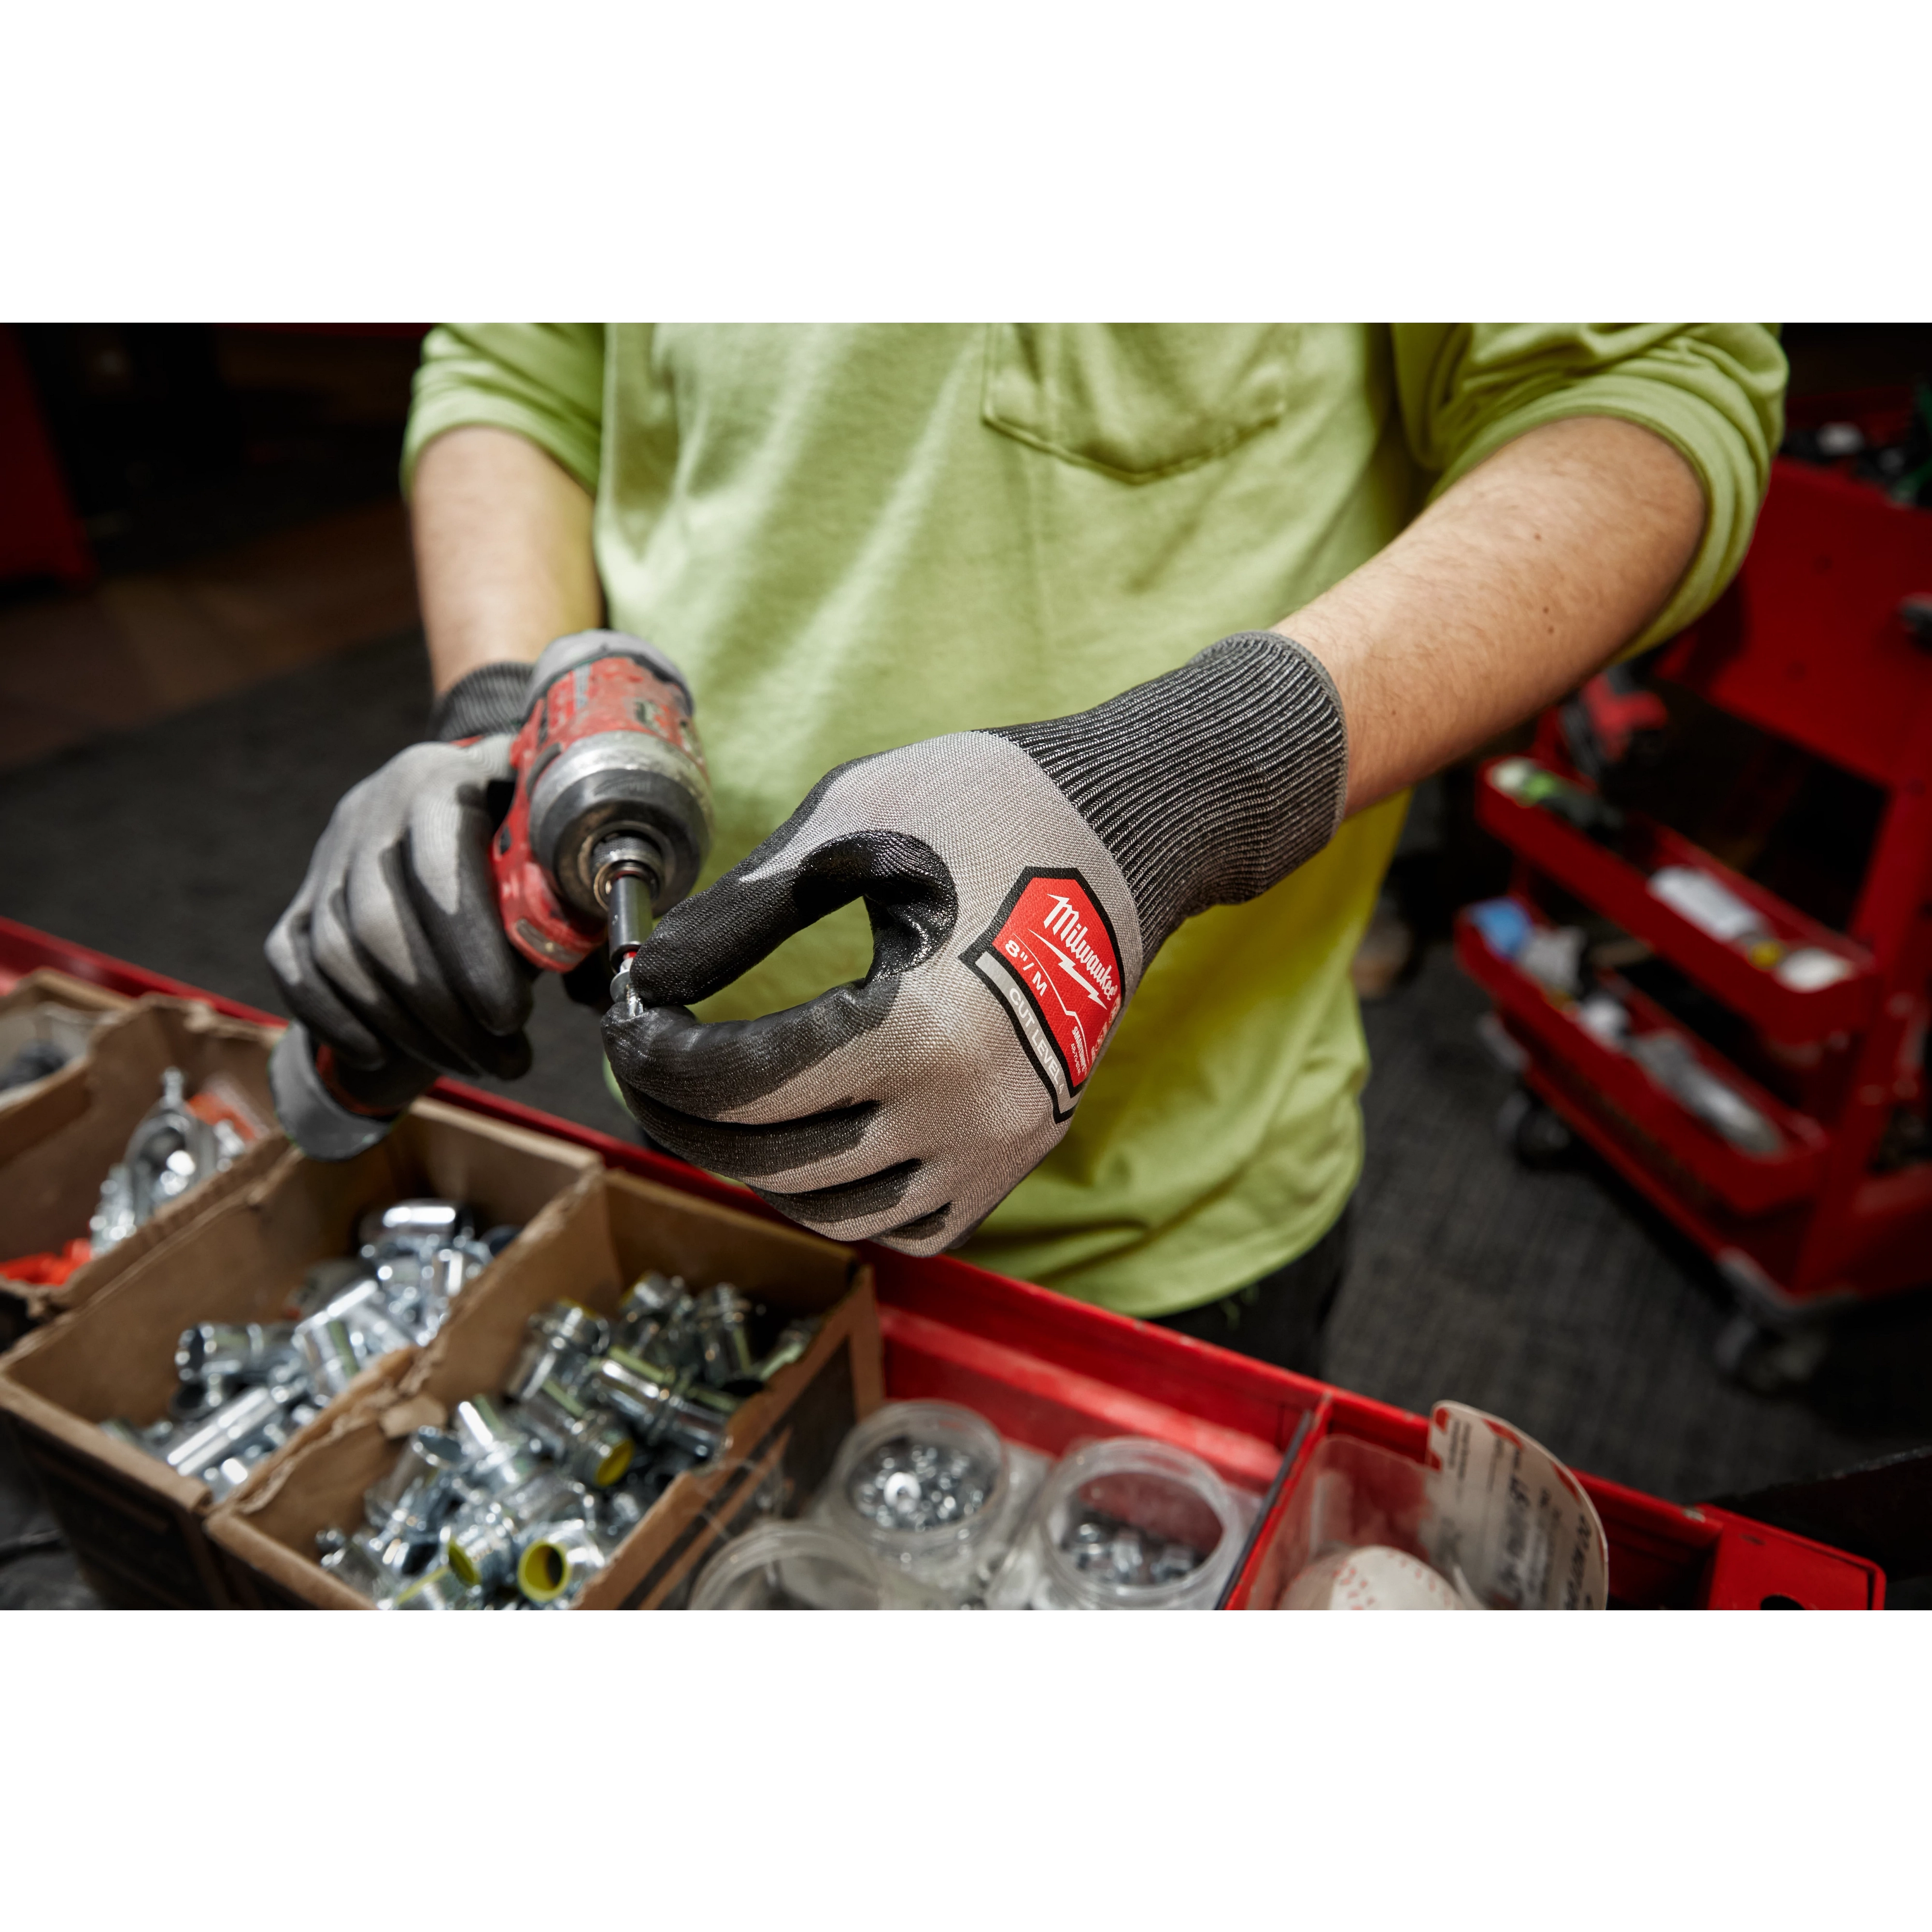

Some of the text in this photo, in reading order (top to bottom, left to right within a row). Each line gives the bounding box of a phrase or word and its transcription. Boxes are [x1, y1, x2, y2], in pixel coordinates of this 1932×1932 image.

[1043, 894, 1113, 1001] Milwaukee
[1009, 988, 1065, 1094] CUT LEVEL 4
